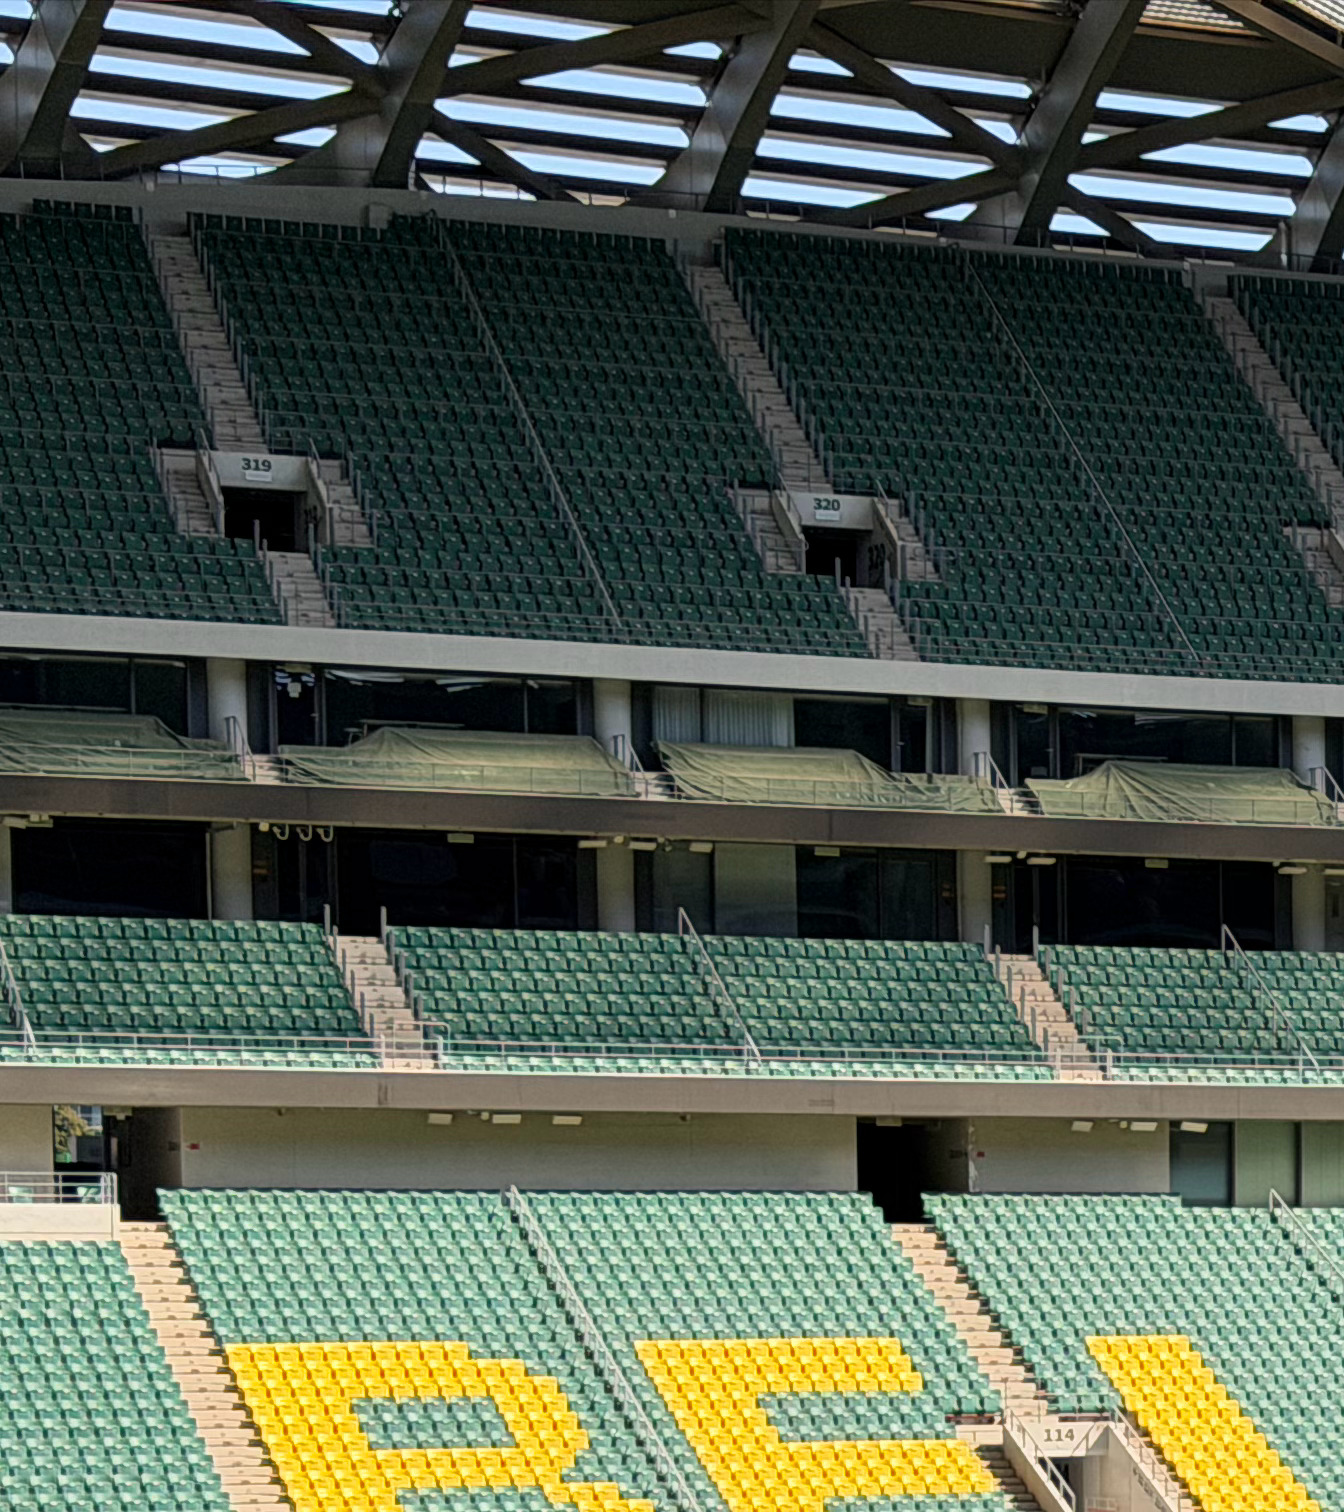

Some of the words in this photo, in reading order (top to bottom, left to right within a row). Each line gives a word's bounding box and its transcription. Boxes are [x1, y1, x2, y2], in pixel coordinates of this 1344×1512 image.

[241, 458, 272, 472] 319
[813, 497, 841, 511] 320
[1043, 1428, 1076, 1443] 114
